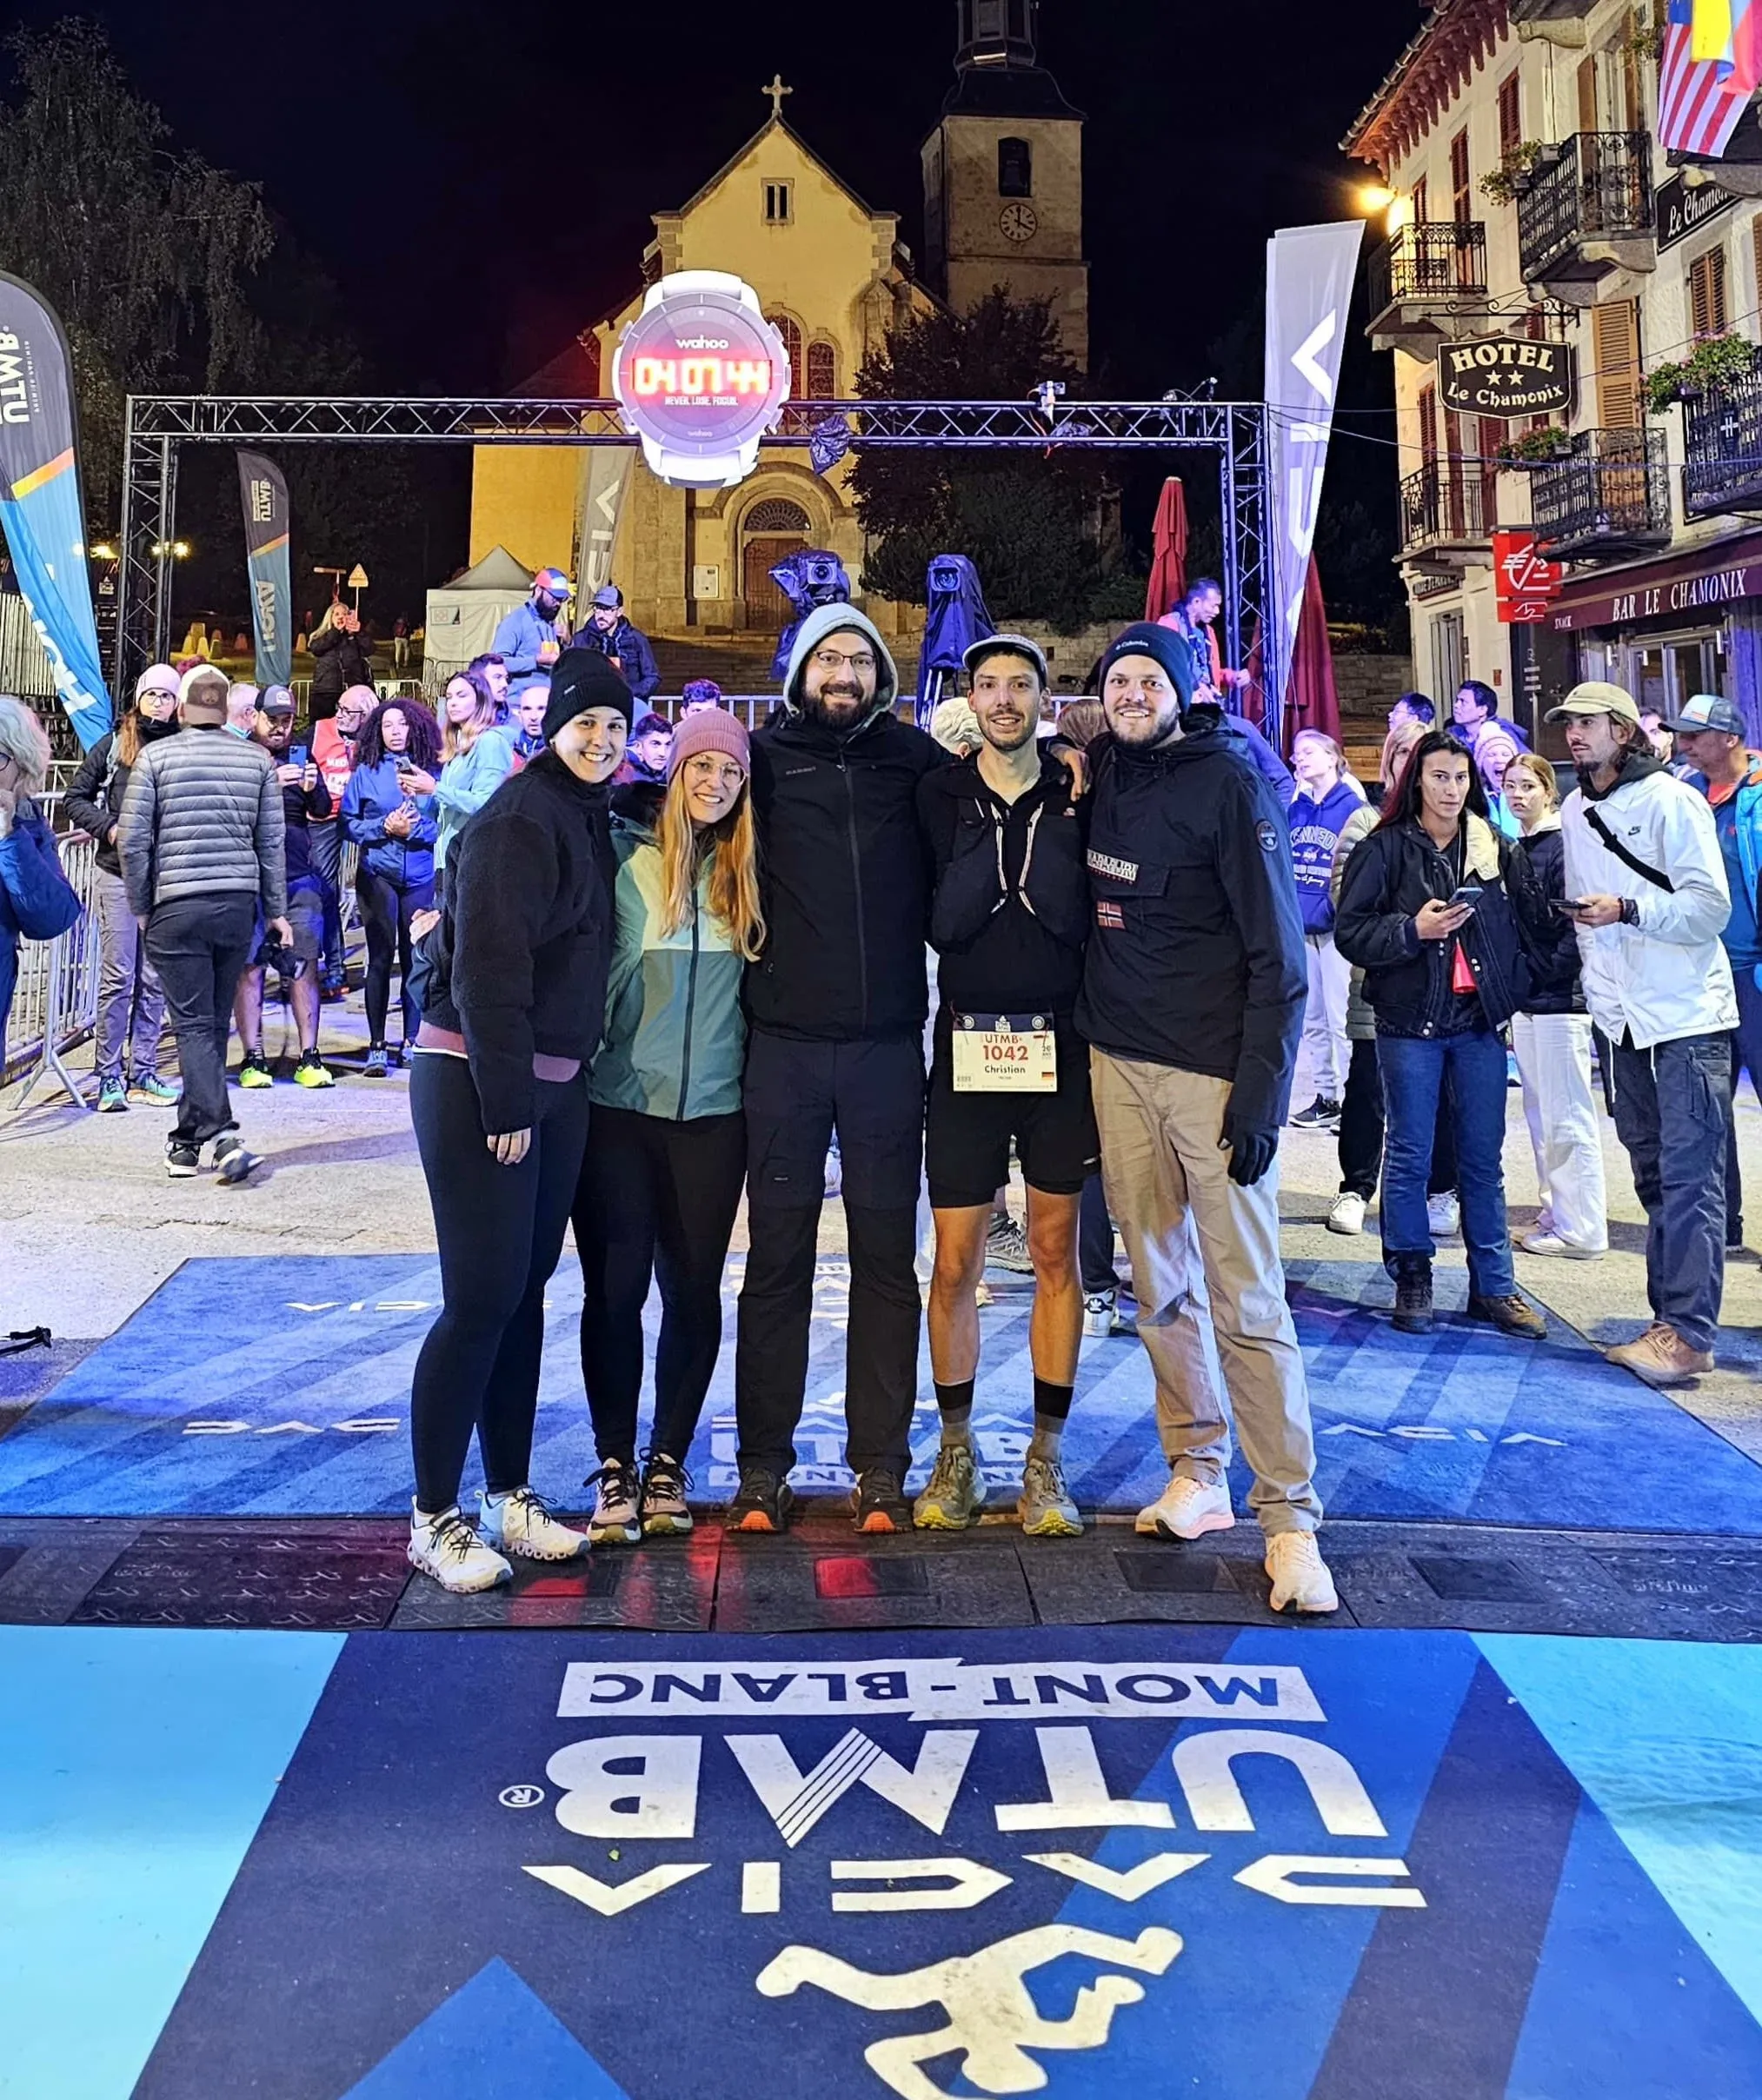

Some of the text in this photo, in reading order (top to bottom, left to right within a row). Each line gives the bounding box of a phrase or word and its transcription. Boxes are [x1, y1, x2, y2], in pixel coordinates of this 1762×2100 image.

[1668, 205, 1682, 238] Le
[676, 335, 728, 349] wahoo
[1449, 343, 1554, 373] HOTEL
[1447, 381, 1564, 408] Le Chamonix
[1612, 567, 1748, 621] BAR LE CHAMONIX
[983, 1045, 1029, 1060] 1042
[985, 1034, 1019, 1044] UTMB
[984, 1065, 1027, 1073] Christian
[590, 1670, 1280, 1706] MONT-BLANC
[521, 1851, 1428, 1916] DACIA
